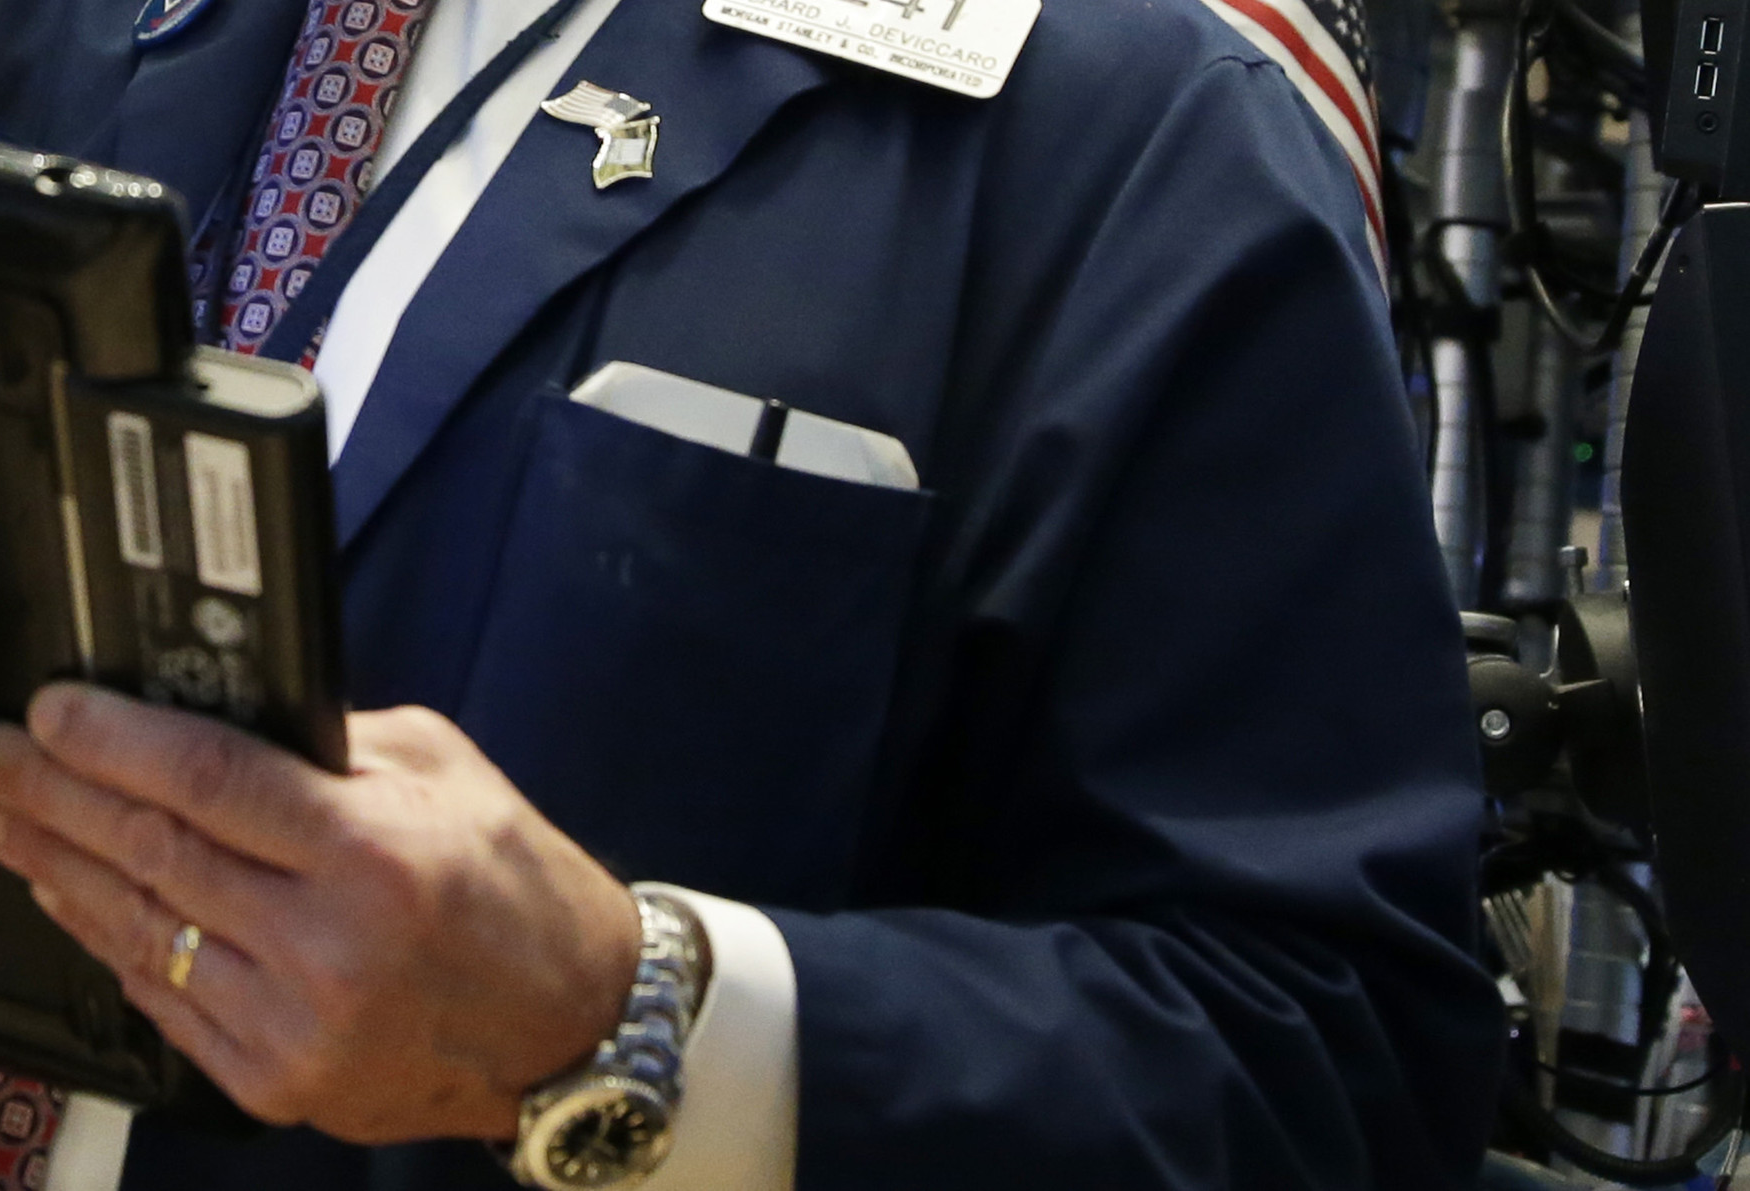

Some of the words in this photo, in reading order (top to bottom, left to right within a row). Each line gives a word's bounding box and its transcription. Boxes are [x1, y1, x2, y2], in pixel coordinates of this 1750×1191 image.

[777, 20, 832, 44] STANLEY
[889, 52, 984, 88] INCORPORATED
[868, 22, 998, 71] DEVICCARO
